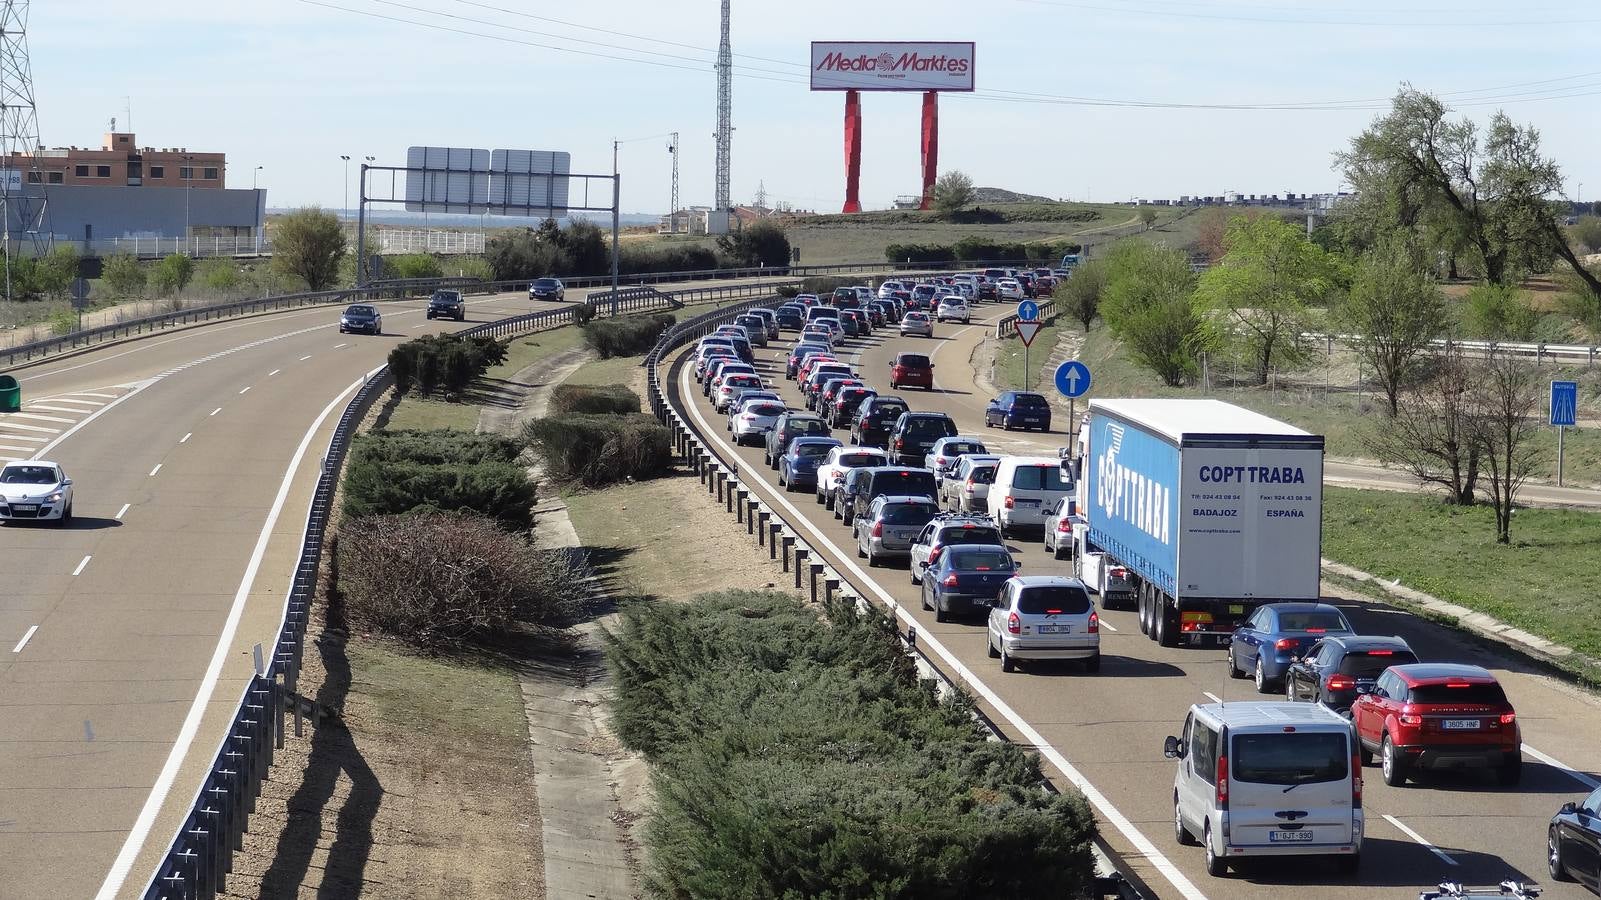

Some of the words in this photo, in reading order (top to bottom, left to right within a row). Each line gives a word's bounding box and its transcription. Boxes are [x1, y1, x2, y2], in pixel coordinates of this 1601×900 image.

[816, 52, 877, 71] Media
[1192, 508, 1237, 517] BADAJOZ
[1266, 508, 1305, 518] ESPAÑA
